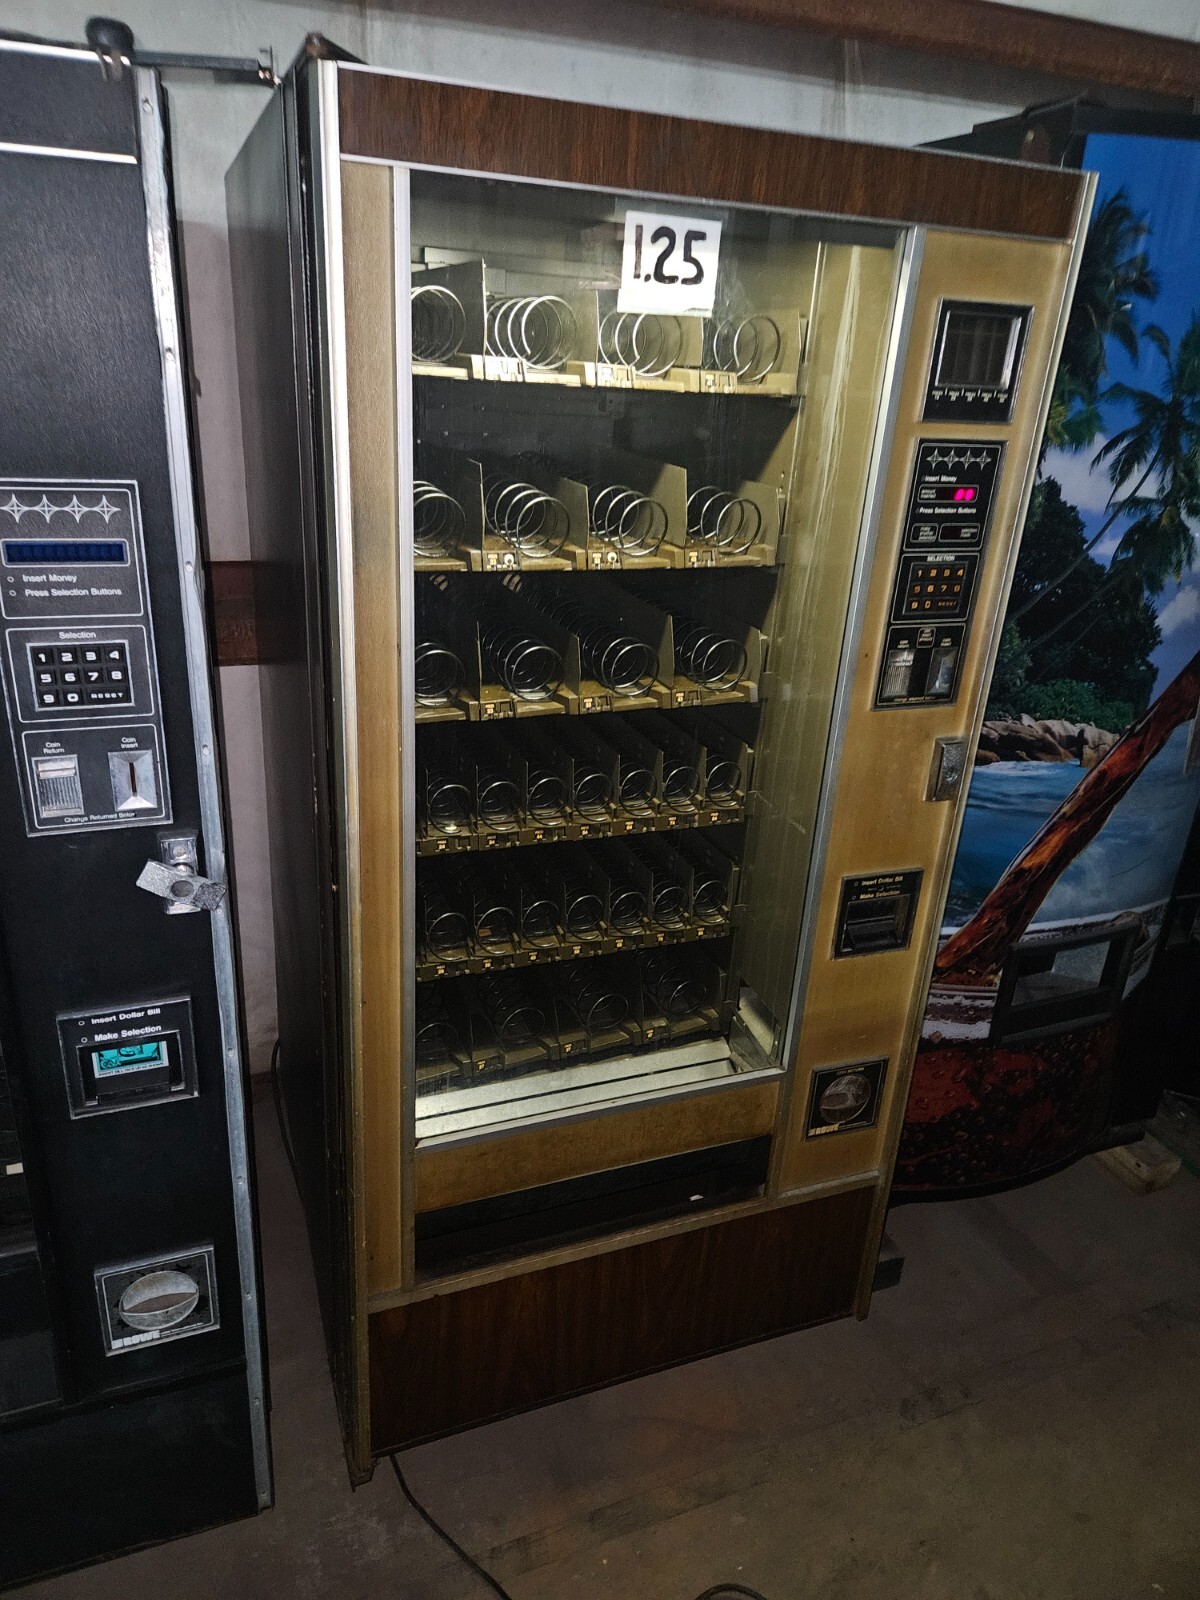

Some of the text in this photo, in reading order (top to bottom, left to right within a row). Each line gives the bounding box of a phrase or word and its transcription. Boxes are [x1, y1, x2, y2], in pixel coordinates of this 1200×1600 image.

[633, 224, 707, 286] 1.25
[48, 574, 77, 583] Money
[50, 588, 88, 596] Selection
[90, 588, 122, 596] Buttons
[59, 631, 96, 639] Selection
[38, 650, 119, 662] 1 2 3 4
[40, 671, 122, 682] 5 6 7 8
[43, 694, 54, 704] 9
[67, 694, 78, 702] 0
[91, 1016, 116, 1024] Insert
[119, 1012, 144, 1020] Dollar
[94, 1025, 162, 1042] Make Selection
